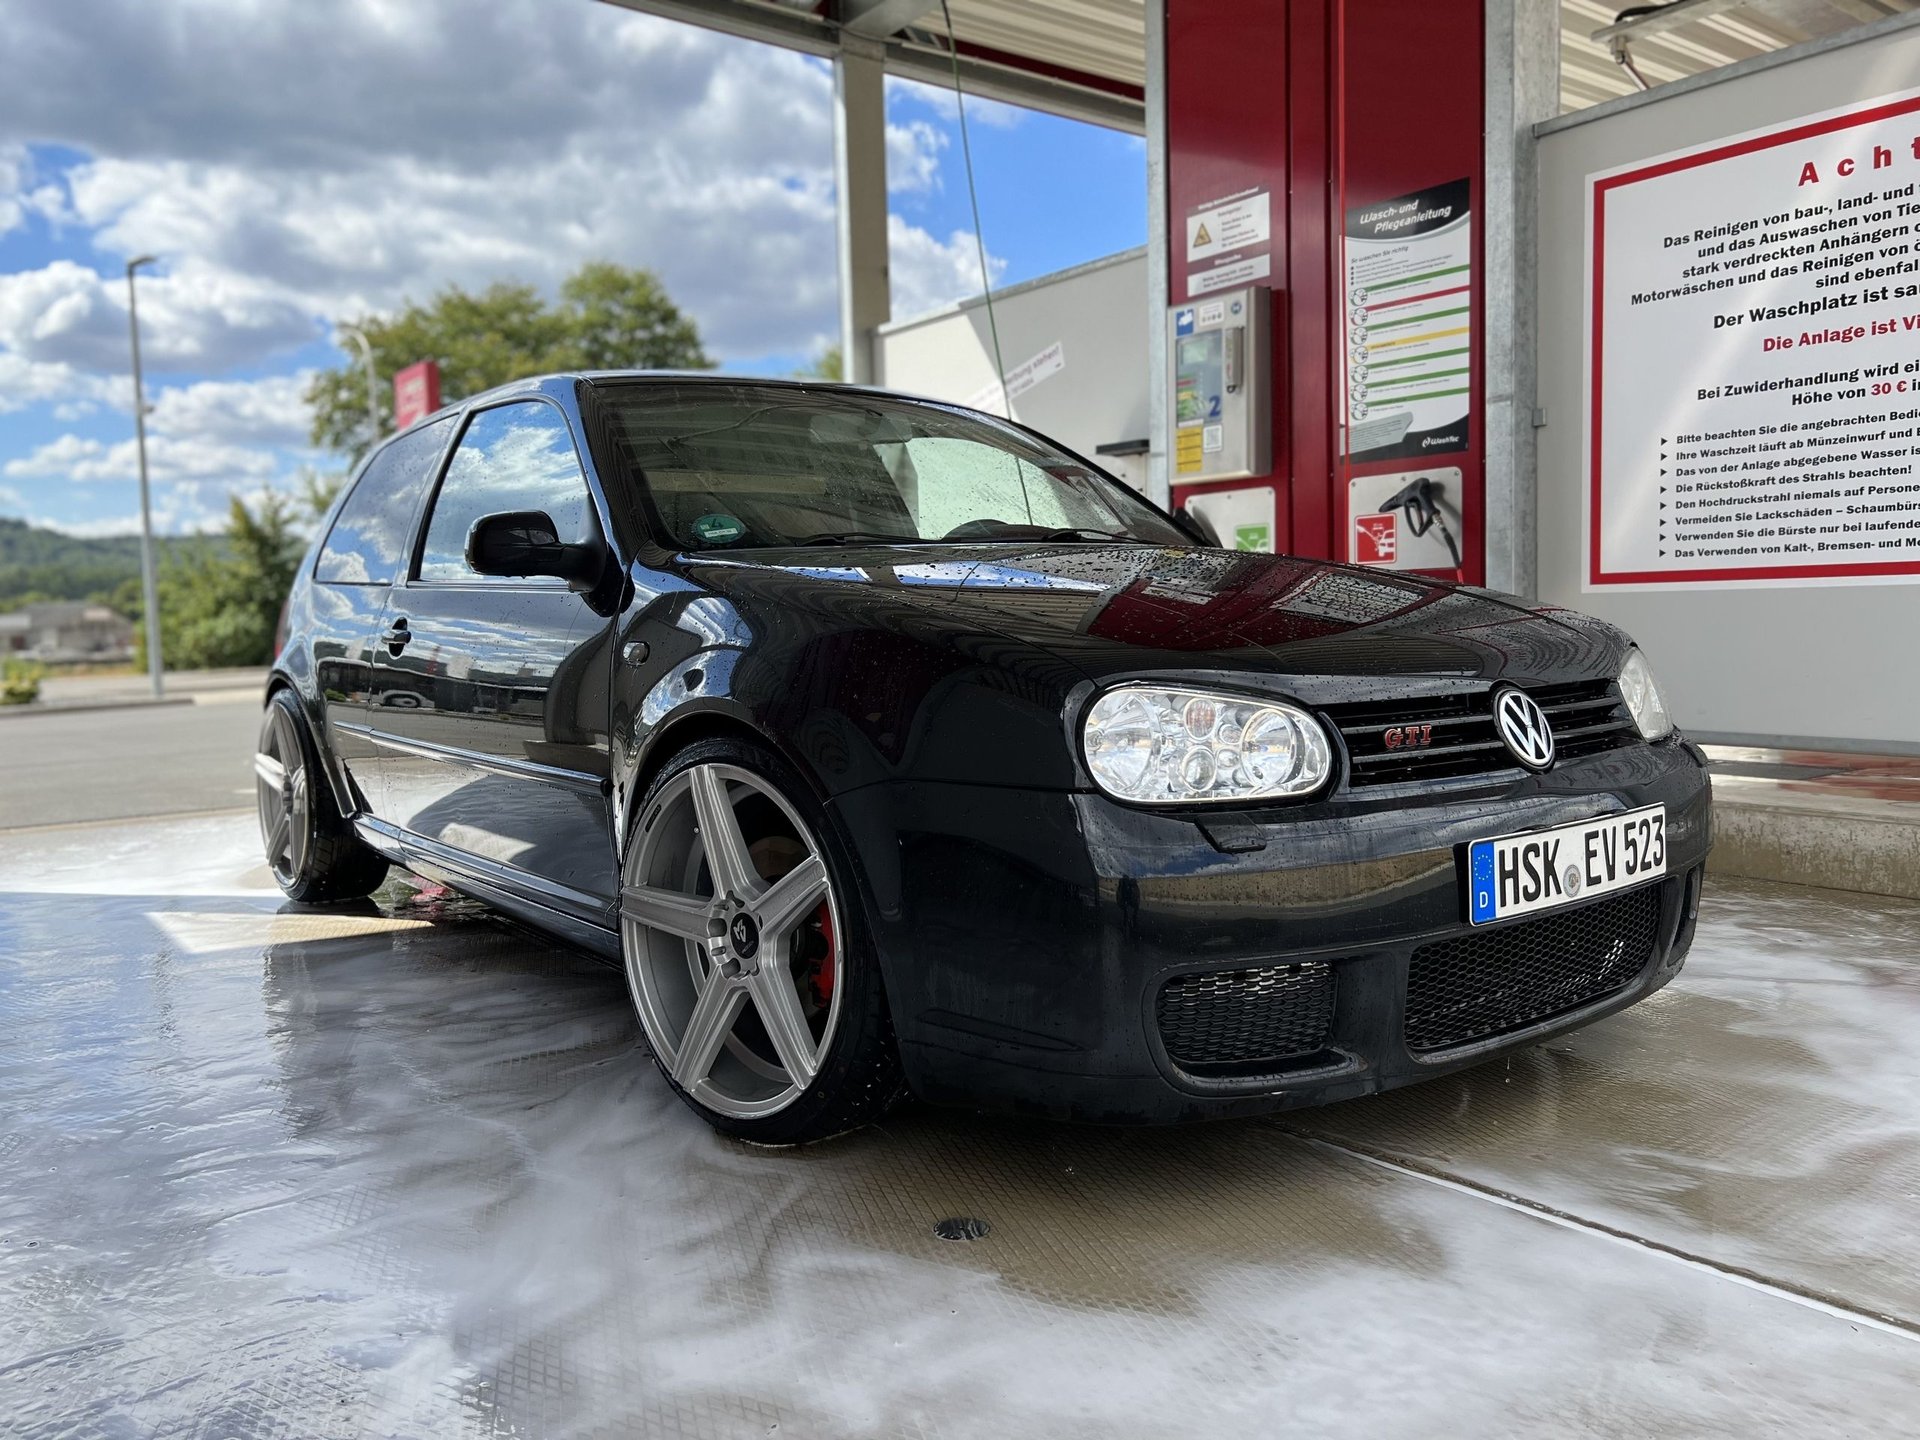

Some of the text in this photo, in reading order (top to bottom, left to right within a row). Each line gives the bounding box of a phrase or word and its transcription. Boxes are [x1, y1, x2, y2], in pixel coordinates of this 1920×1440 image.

[1360, 199, 1419, 224] Wasch- und
[1374, 206, 1452, 234] Pflegeanleitung
[1664, 235, 1690, 248] Das
[1694, 220, 1758, 241] Reinigen
[1763, 213, 1789, 226] von
[1795, 205, 1833, 220] bau-,
[1838, 192, 1878, 210] land-
[1883, 183, 1914, 200] und
[1698, 242, 1724, 258] und
[1729, 238, 1755, 251] das
[1759, 217, 1858, 245] Auswaschen
[1863, 210, 1892, 223] von
[1682, 262, 1720, 278] stark
[1723, 243, 1815, 270] verdreckten
[1819, 225, 1909, 251] Anhängern
[1631, 278, 1734, 305] Motorwäschen
[1738, 269, 1766, 285] und
[1770, 265, 1798, 279] das
[1802, 251, 1874, 273] Reinigen
[1879, 244, 1909, 258] von
[1815, 259, 1919, 288] sind ebenfal
[1713, 284, 1920, 329] Der Waschplatz ist sa
[1763, 336, 1793, 352] Die
[1798, 326, 1865, 346] Anlage
[1871, 318, 1897, 336] ist
[1697, 386, 1720, 400] Bei
[1724, 368, 1860, 397] Zuwiderhandlung
[1864, 362, 1899, 378] wird
[1792, 391, 1833, 406] Höhe
[1837, 388, 1866, 400] von
[1871, 382, 1892, 396] 30
[1896, 380, 1907, 393] €
[1208, 395, 1222, 418] 2
[1676, 435, 1702, 444] Bitte
[1704, 428, 1756, 441] beachten
[1758, 425, 1777, 435] Sie
[1780, 423, 1798, 433] die
[1801, 414, 1886, 431] angebrachten
[1676, 452, 1697, 461] Ihre
[1700, 444, 1757, 458] Waschzeit
[1759, 441, 1787, 452] läuft
[1789, 440, 1804, 449] ab
[1807, 430, 1886, 447] Münzeinwurf
[1889, 428, 1913, 439] und
[1676, 468, 1696, 477] Das
[1699, 466, 1718, 475] von
[1720, 464, 1739, 473] der
[1741, 460, 1781, 471] Anlage
[1783, 453, 1858, 467] abgegebene
[1861, 448, 1908, 460] Wasser
[1675, 465, 1912, 493] Die Rückstoßkraft des Strahls beachten!
[1675, 500, 1696, 509] Den
[1699, 492, 1791, 508] Hochdruckstrahl
[1793, 489, 1841, 501] niemals
[1844, 486, 1865, 497] auf
[711, 518, 724, 528] 4
[1675, 514, 1732, 525] Vermeiden
[1735, 512, 1753, 522] Sie
[1755, 507, 1833, 520] Lackschäden
[1675, 531, 1734, 541] Verwenden
[1736, 529, 1755, 538] Sie
[1757, 528, 1775, 537] die
[1778, 524, 1817, 536] Bürste
[1820, 525, 1840, 533] nur
[1843, 522, 1862, 532] bei
[1674, 549, 1695, 558] Das
[1697, 546, 1758, 557] Verwenden
[1760, 545, 1780, 554] von
[1784, 543, 1814, 553] Kalt-,
[1817, 540, 1876, 551] Bremsen-
[1878, 538, 1902, 548] und
[1383, 725, 1433, 749] GTI
[1498, 814, 1665, 909] HSK EV 523
[1479, 891, 1489, 908] D
